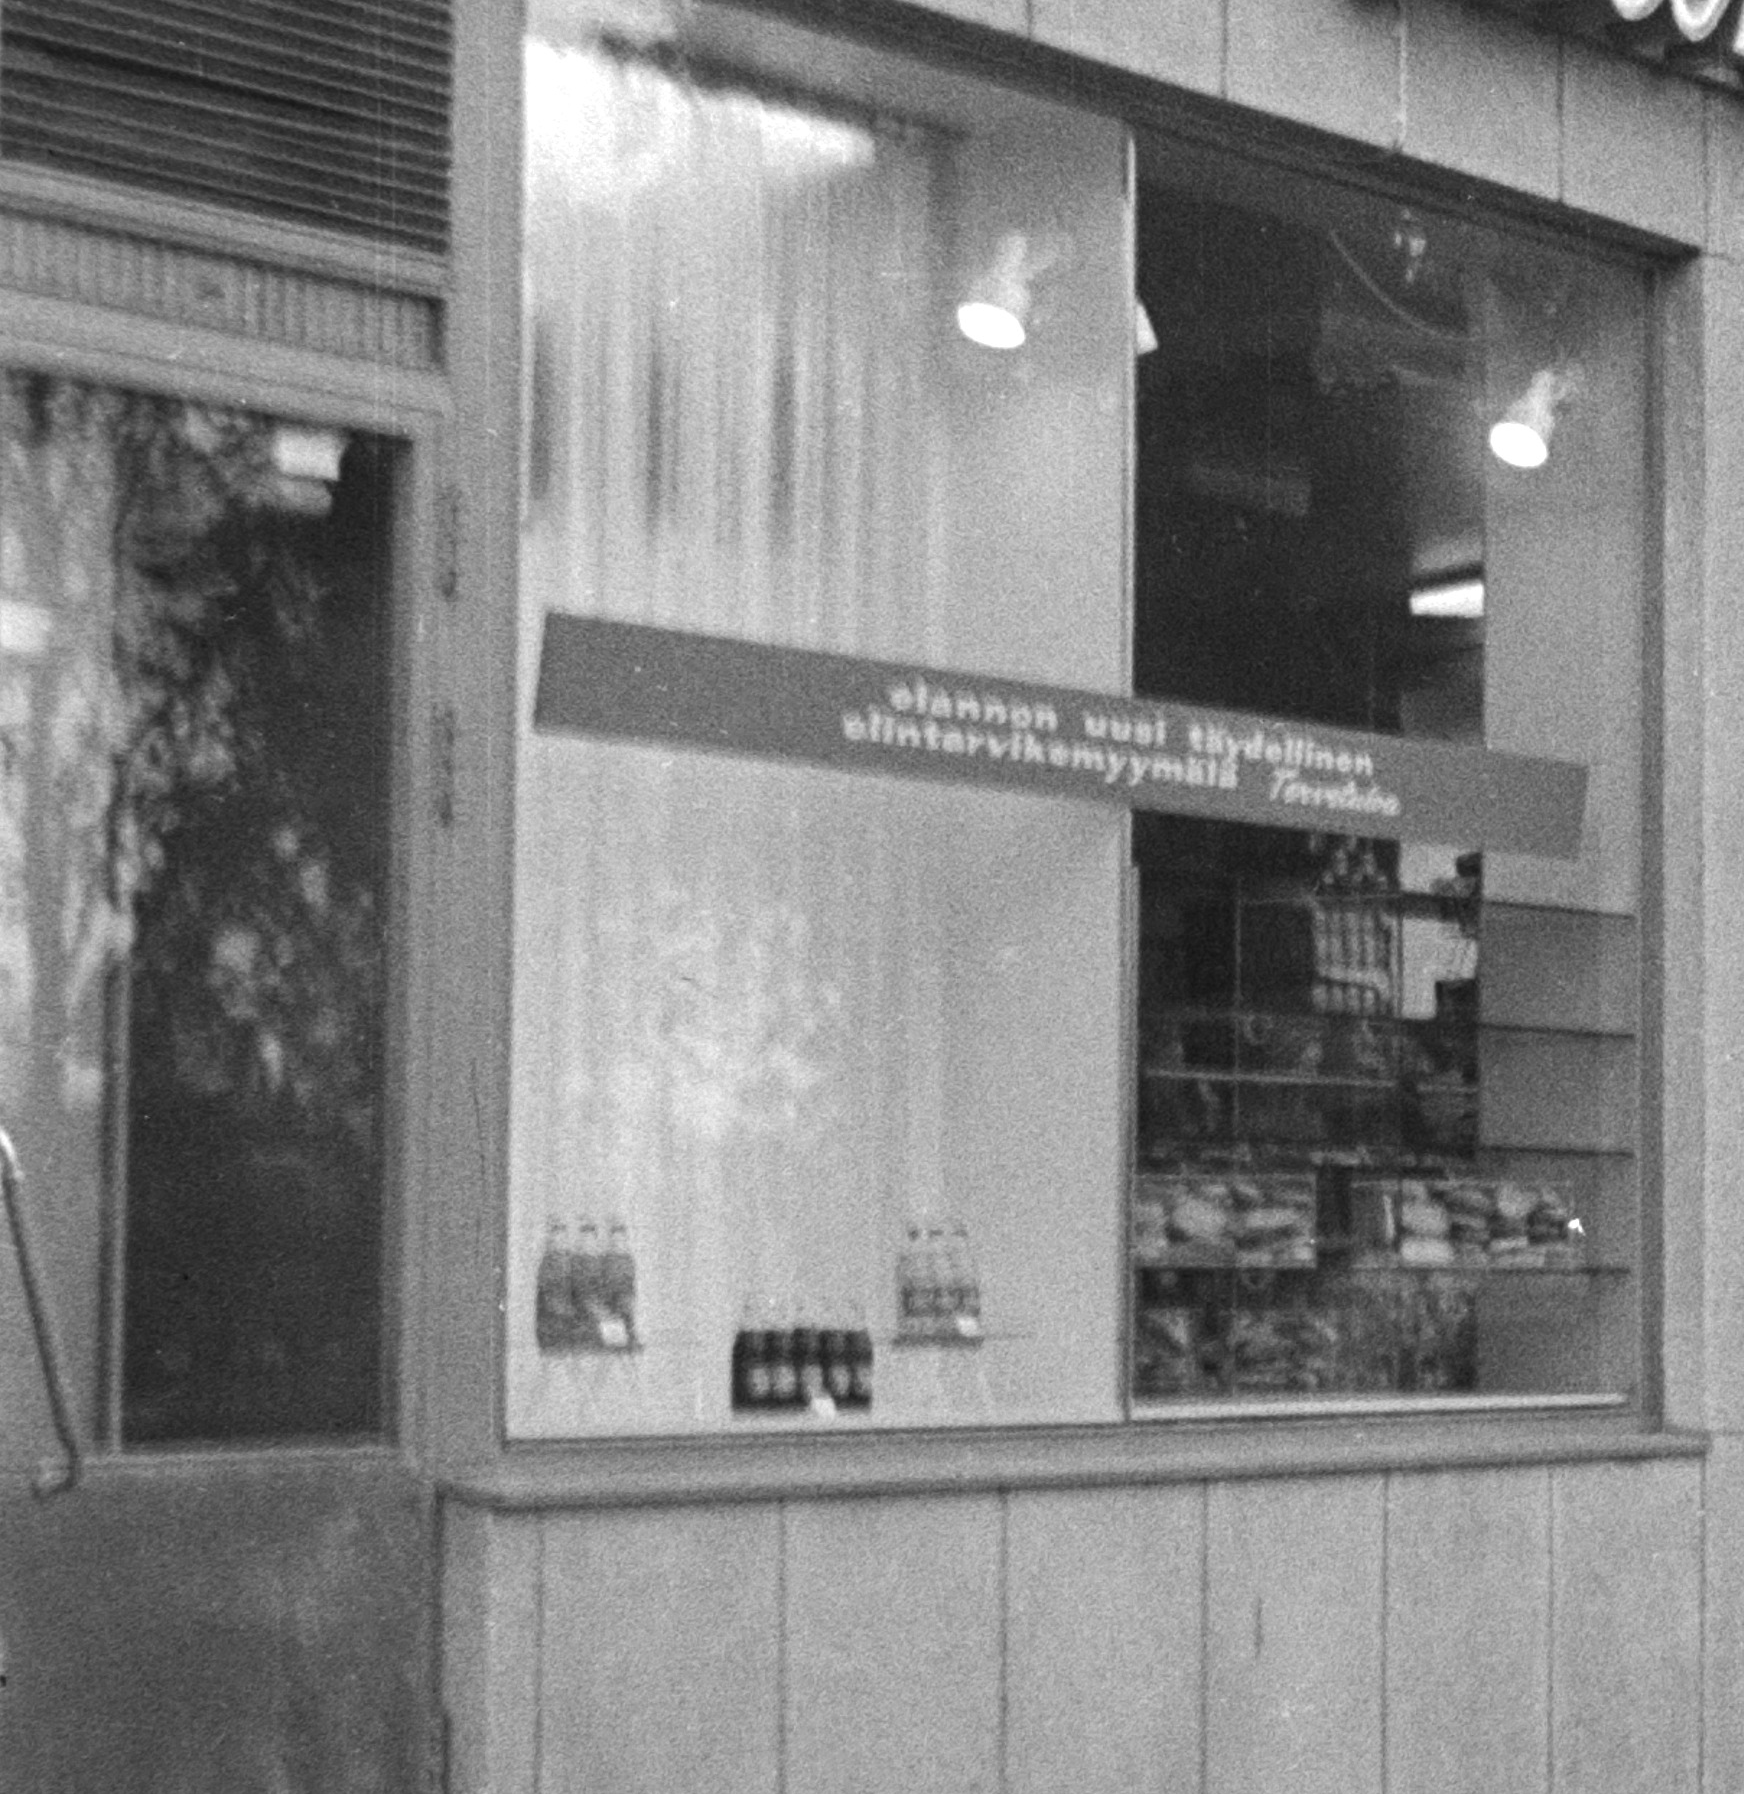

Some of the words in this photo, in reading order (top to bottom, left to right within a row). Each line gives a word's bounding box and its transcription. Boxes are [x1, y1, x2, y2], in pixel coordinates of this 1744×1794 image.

[840, 703, 1239, 790] elintarvikemyymälä
[886, 674, 1058, 732] elannon
[1083, 710, 1167, 747] uusi
[1188, 721, 1375, 777] täydellinen
